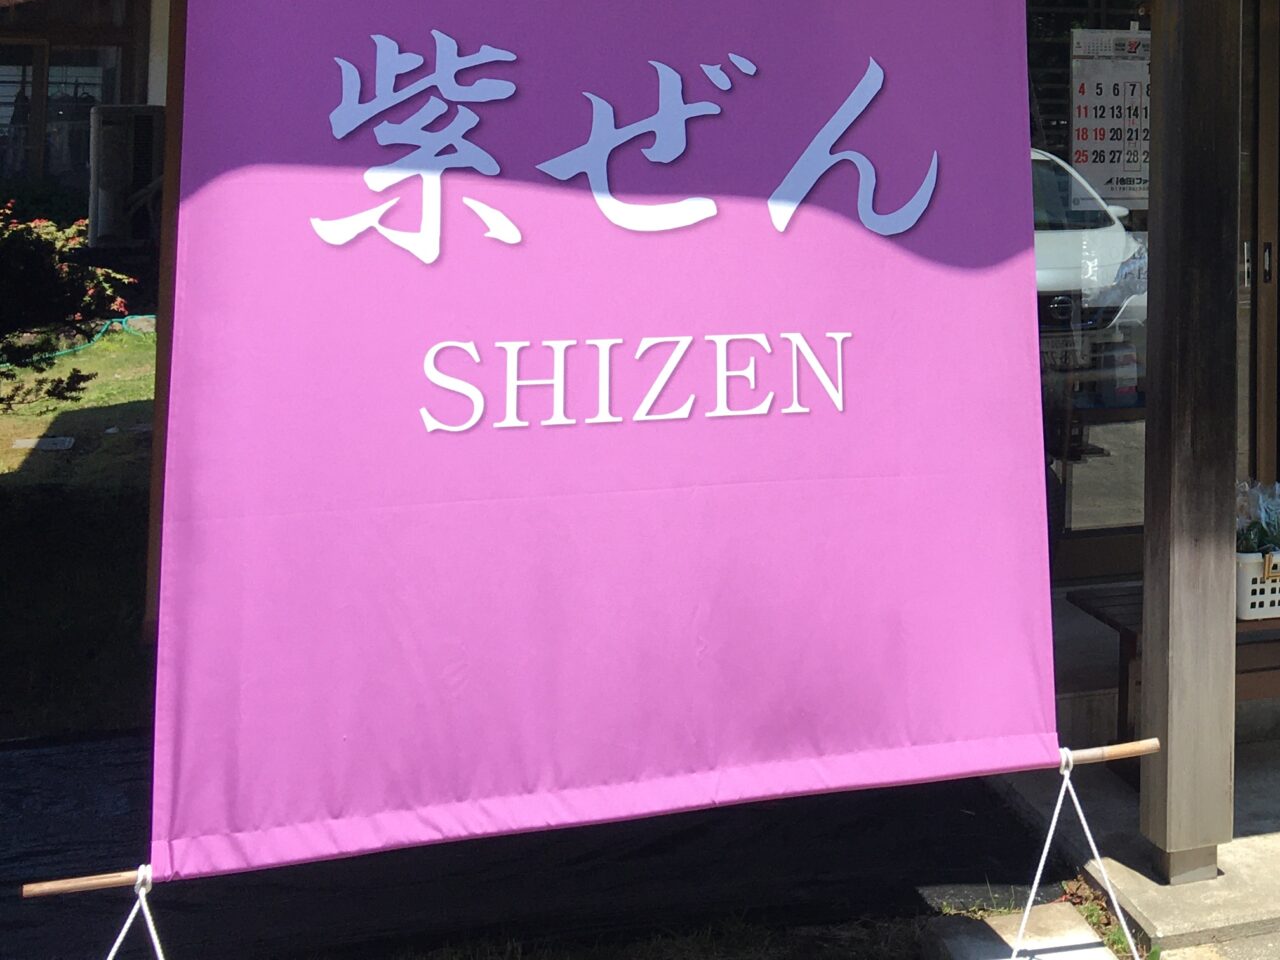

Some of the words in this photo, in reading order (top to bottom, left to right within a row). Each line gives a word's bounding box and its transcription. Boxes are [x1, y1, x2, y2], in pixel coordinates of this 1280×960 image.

[1078, 82, 1086, 96] 4
[1096, 83, 1103, 97] 5
[1112, 83, 1120, 97] 6
[1129, 83, 1137, 97] 7
[1076, 105, 1088, 118] 11
[1093, 105, 1106, 119] 12
[1110, 106, 1122, 119] 13
[1127, 106, 1139, 119] 14
[1075, 127, 1088, 141] 18
[1093, 128, 1106, 141] 19
[1109, 128, 1123, 141] 20
[1126, 128, 1139, 141] 21
[310, 29, 938, 264] 紫ぜん
[1074, 150, 1089, 164] 25
[1092, 150, 1106, 164] 26
[1109, 150, 1122, 164] 27
[1126, 150, 1139, 164] 28
[418, 331, 852, 432] SHIZEN
